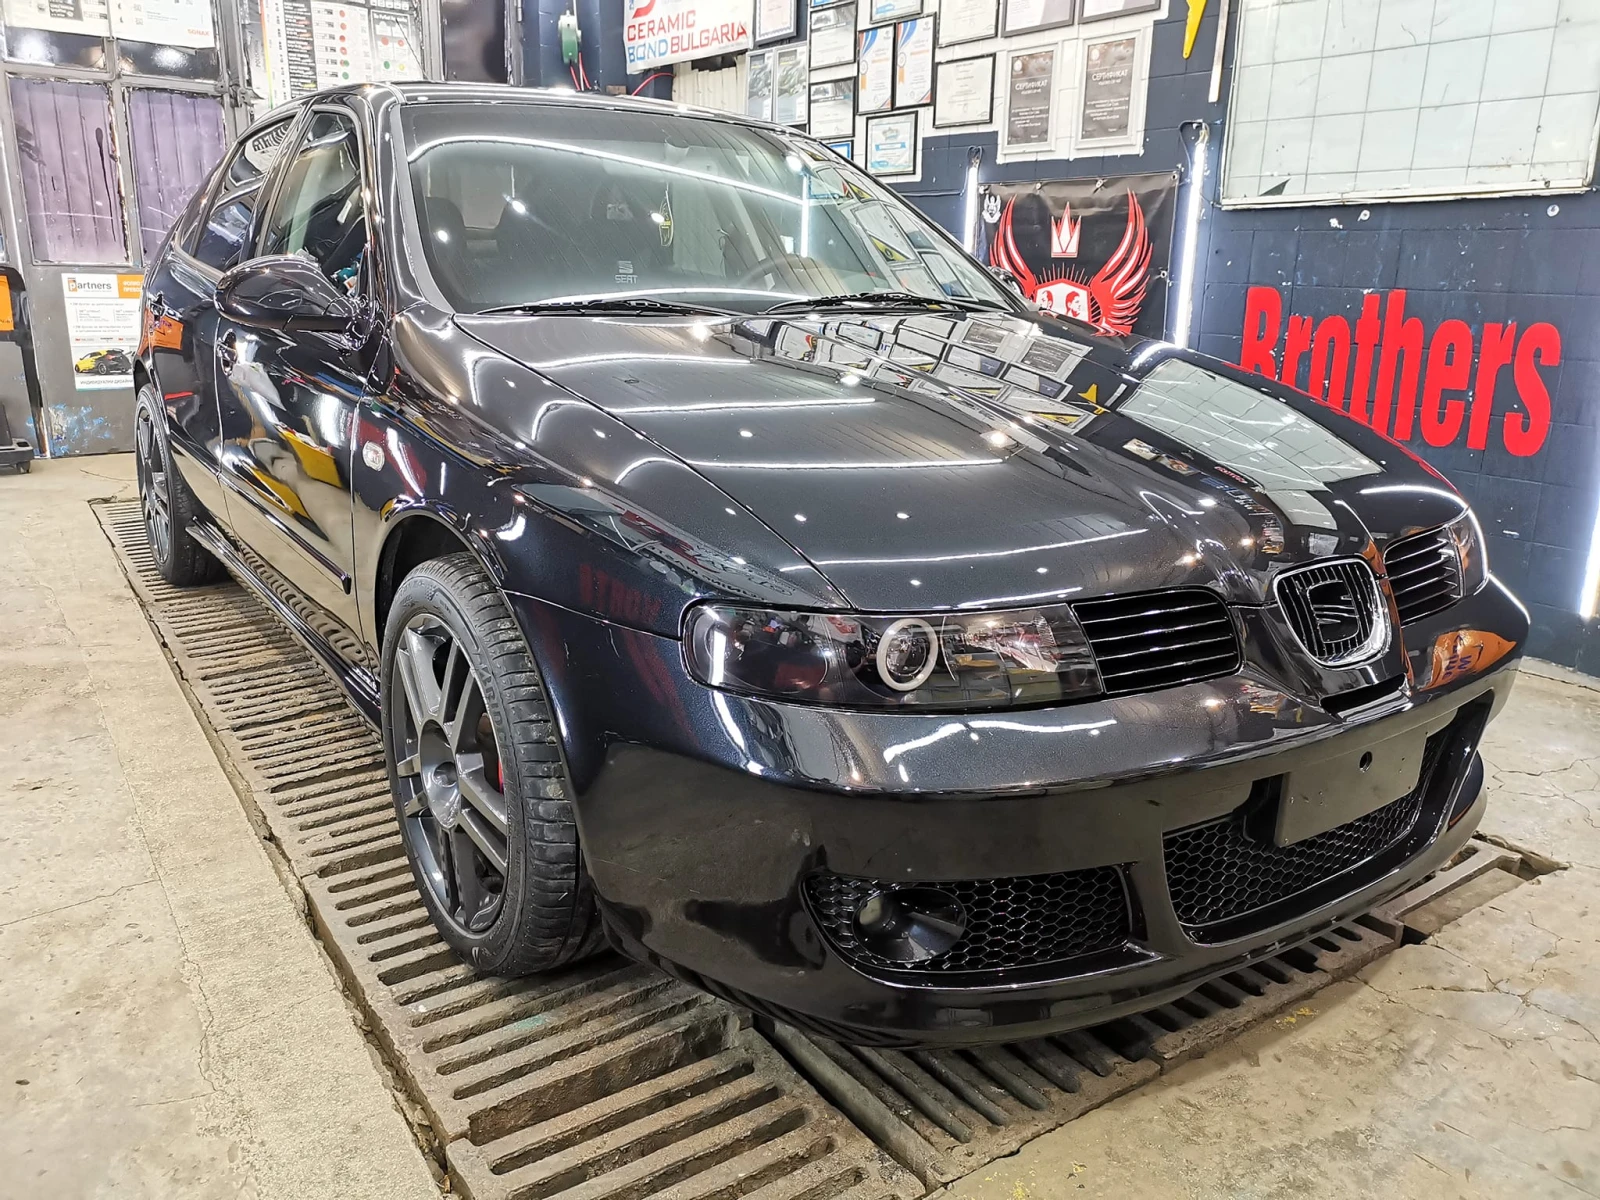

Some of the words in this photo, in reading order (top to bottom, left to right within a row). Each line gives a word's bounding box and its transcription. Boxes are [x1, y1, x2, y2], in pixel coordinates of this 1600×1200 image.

[627, 10, 696, 42] CERAMIC
[627, 38, 669, 63] BOND
[670, 21, 748, 54] BULGARIA
[615, 274, 638, 284] SEAT
[1240, 286, 1562, 457] Brothers
